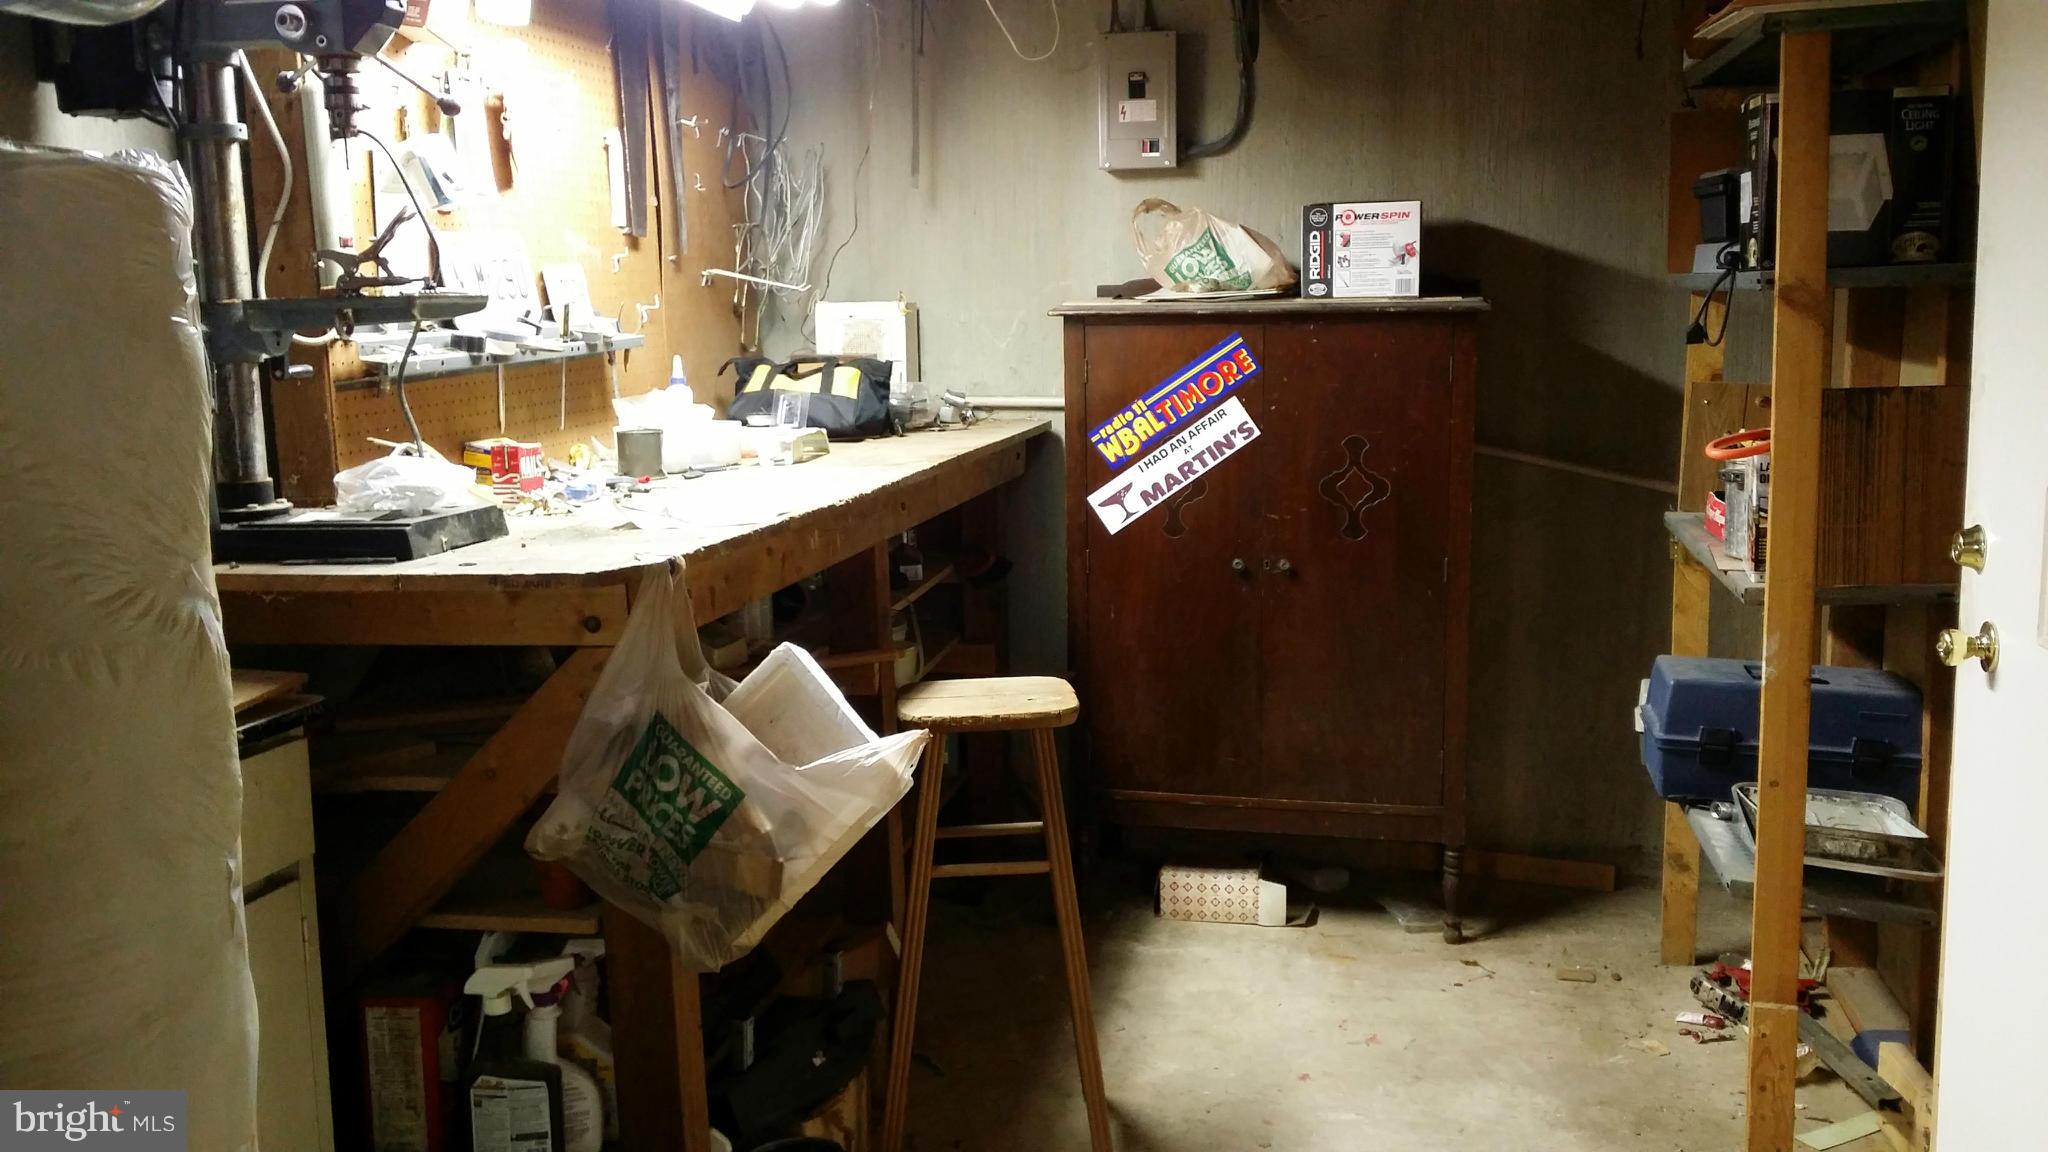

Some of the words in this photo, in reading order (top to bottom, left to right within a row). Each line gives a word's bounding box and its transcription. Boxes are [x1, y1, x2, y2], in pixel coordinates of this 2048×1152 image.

[1904, 120, 1935, 131] LIGHT
[1335, 209, 1411, 226] POWERSPIN
[1309, 230, 1321, 280] RIDGID
[1099, 411, 1134, 439] radio
[1143, 448, 1169, 470] HAD
[1169, 435, 1187, 453] AN
[1188, 408, 1228, 440] AFFAIR
[1140, 420, 1256, 507] MARTIN'S
[1184, 445, 1194, 455] AT
[655, 724, 732, 800] GUARANTEED
